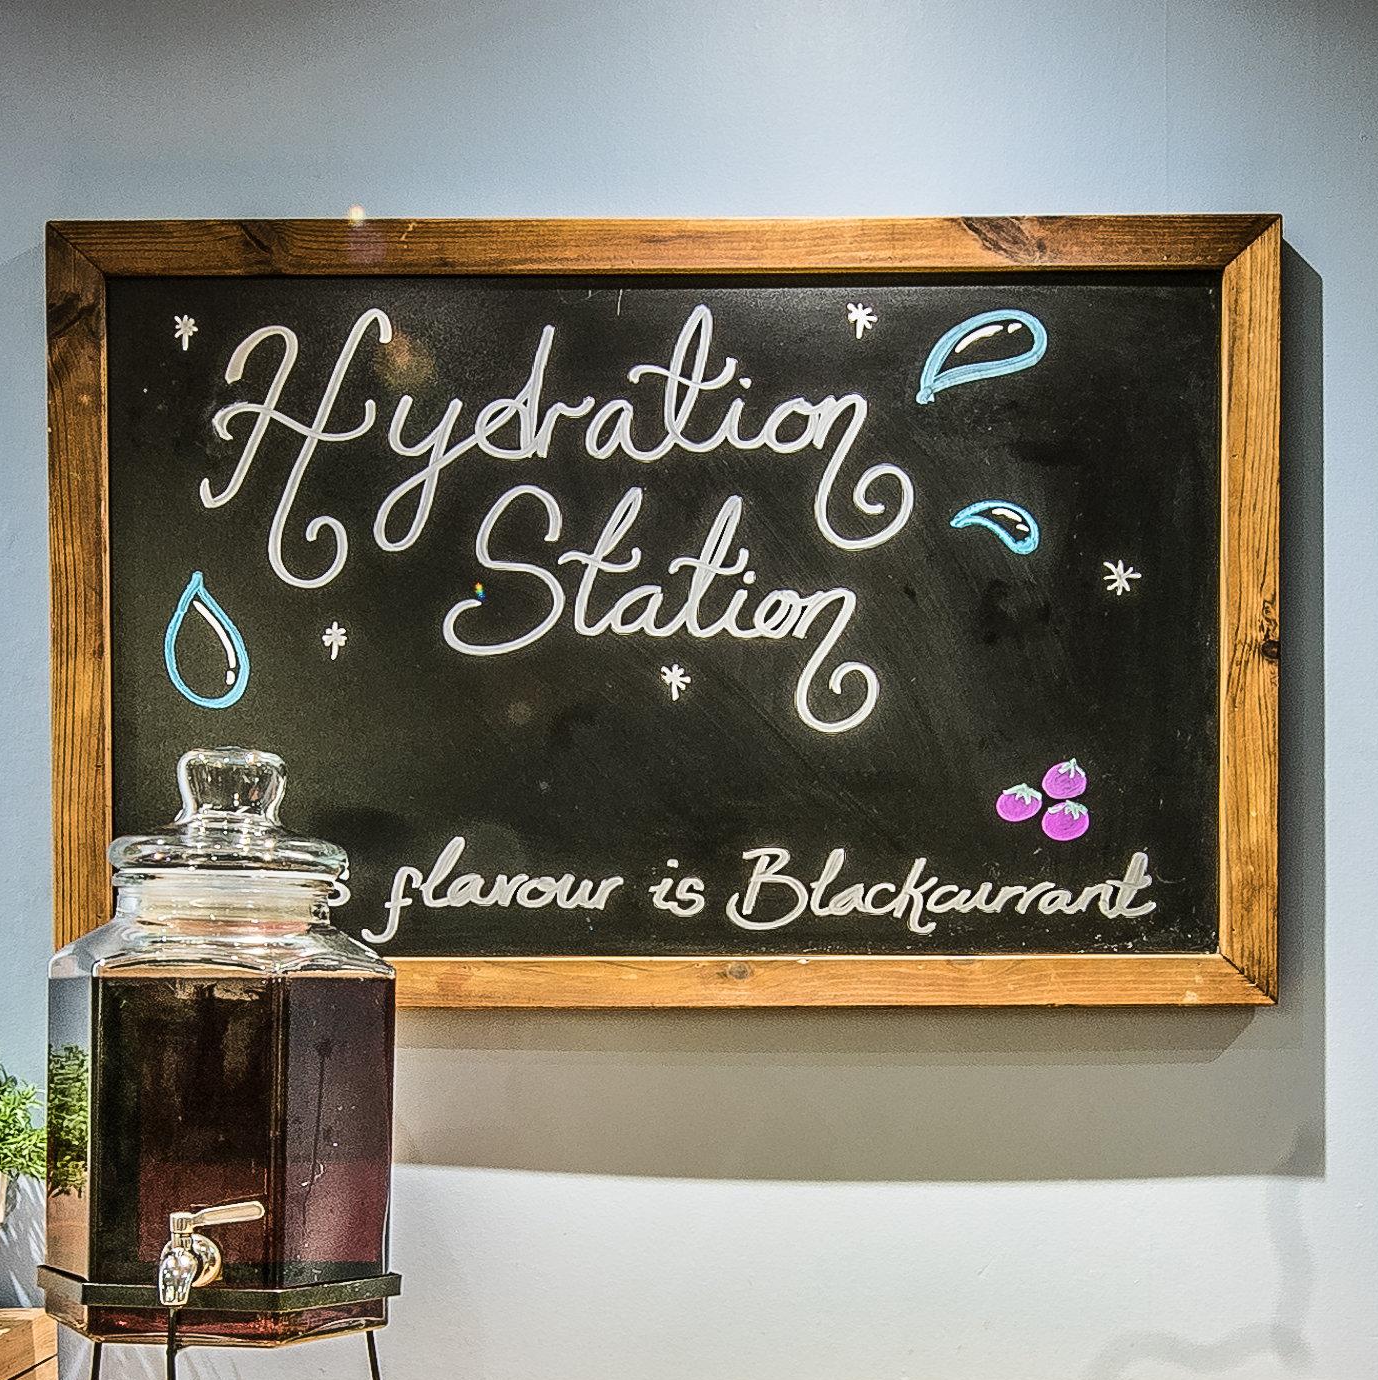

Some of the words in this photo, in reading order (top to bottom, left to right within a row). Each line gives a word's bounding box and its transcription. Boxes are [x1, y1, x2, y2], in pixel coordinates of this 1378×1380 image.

[199, 302, 915, 589] Hydration
[442, 484, 881, 735] Station
[360, 835, 625, 944] flavour
[648, 857, 706, 918] is
[725, 846, 1158, 935] Blackcurrant
